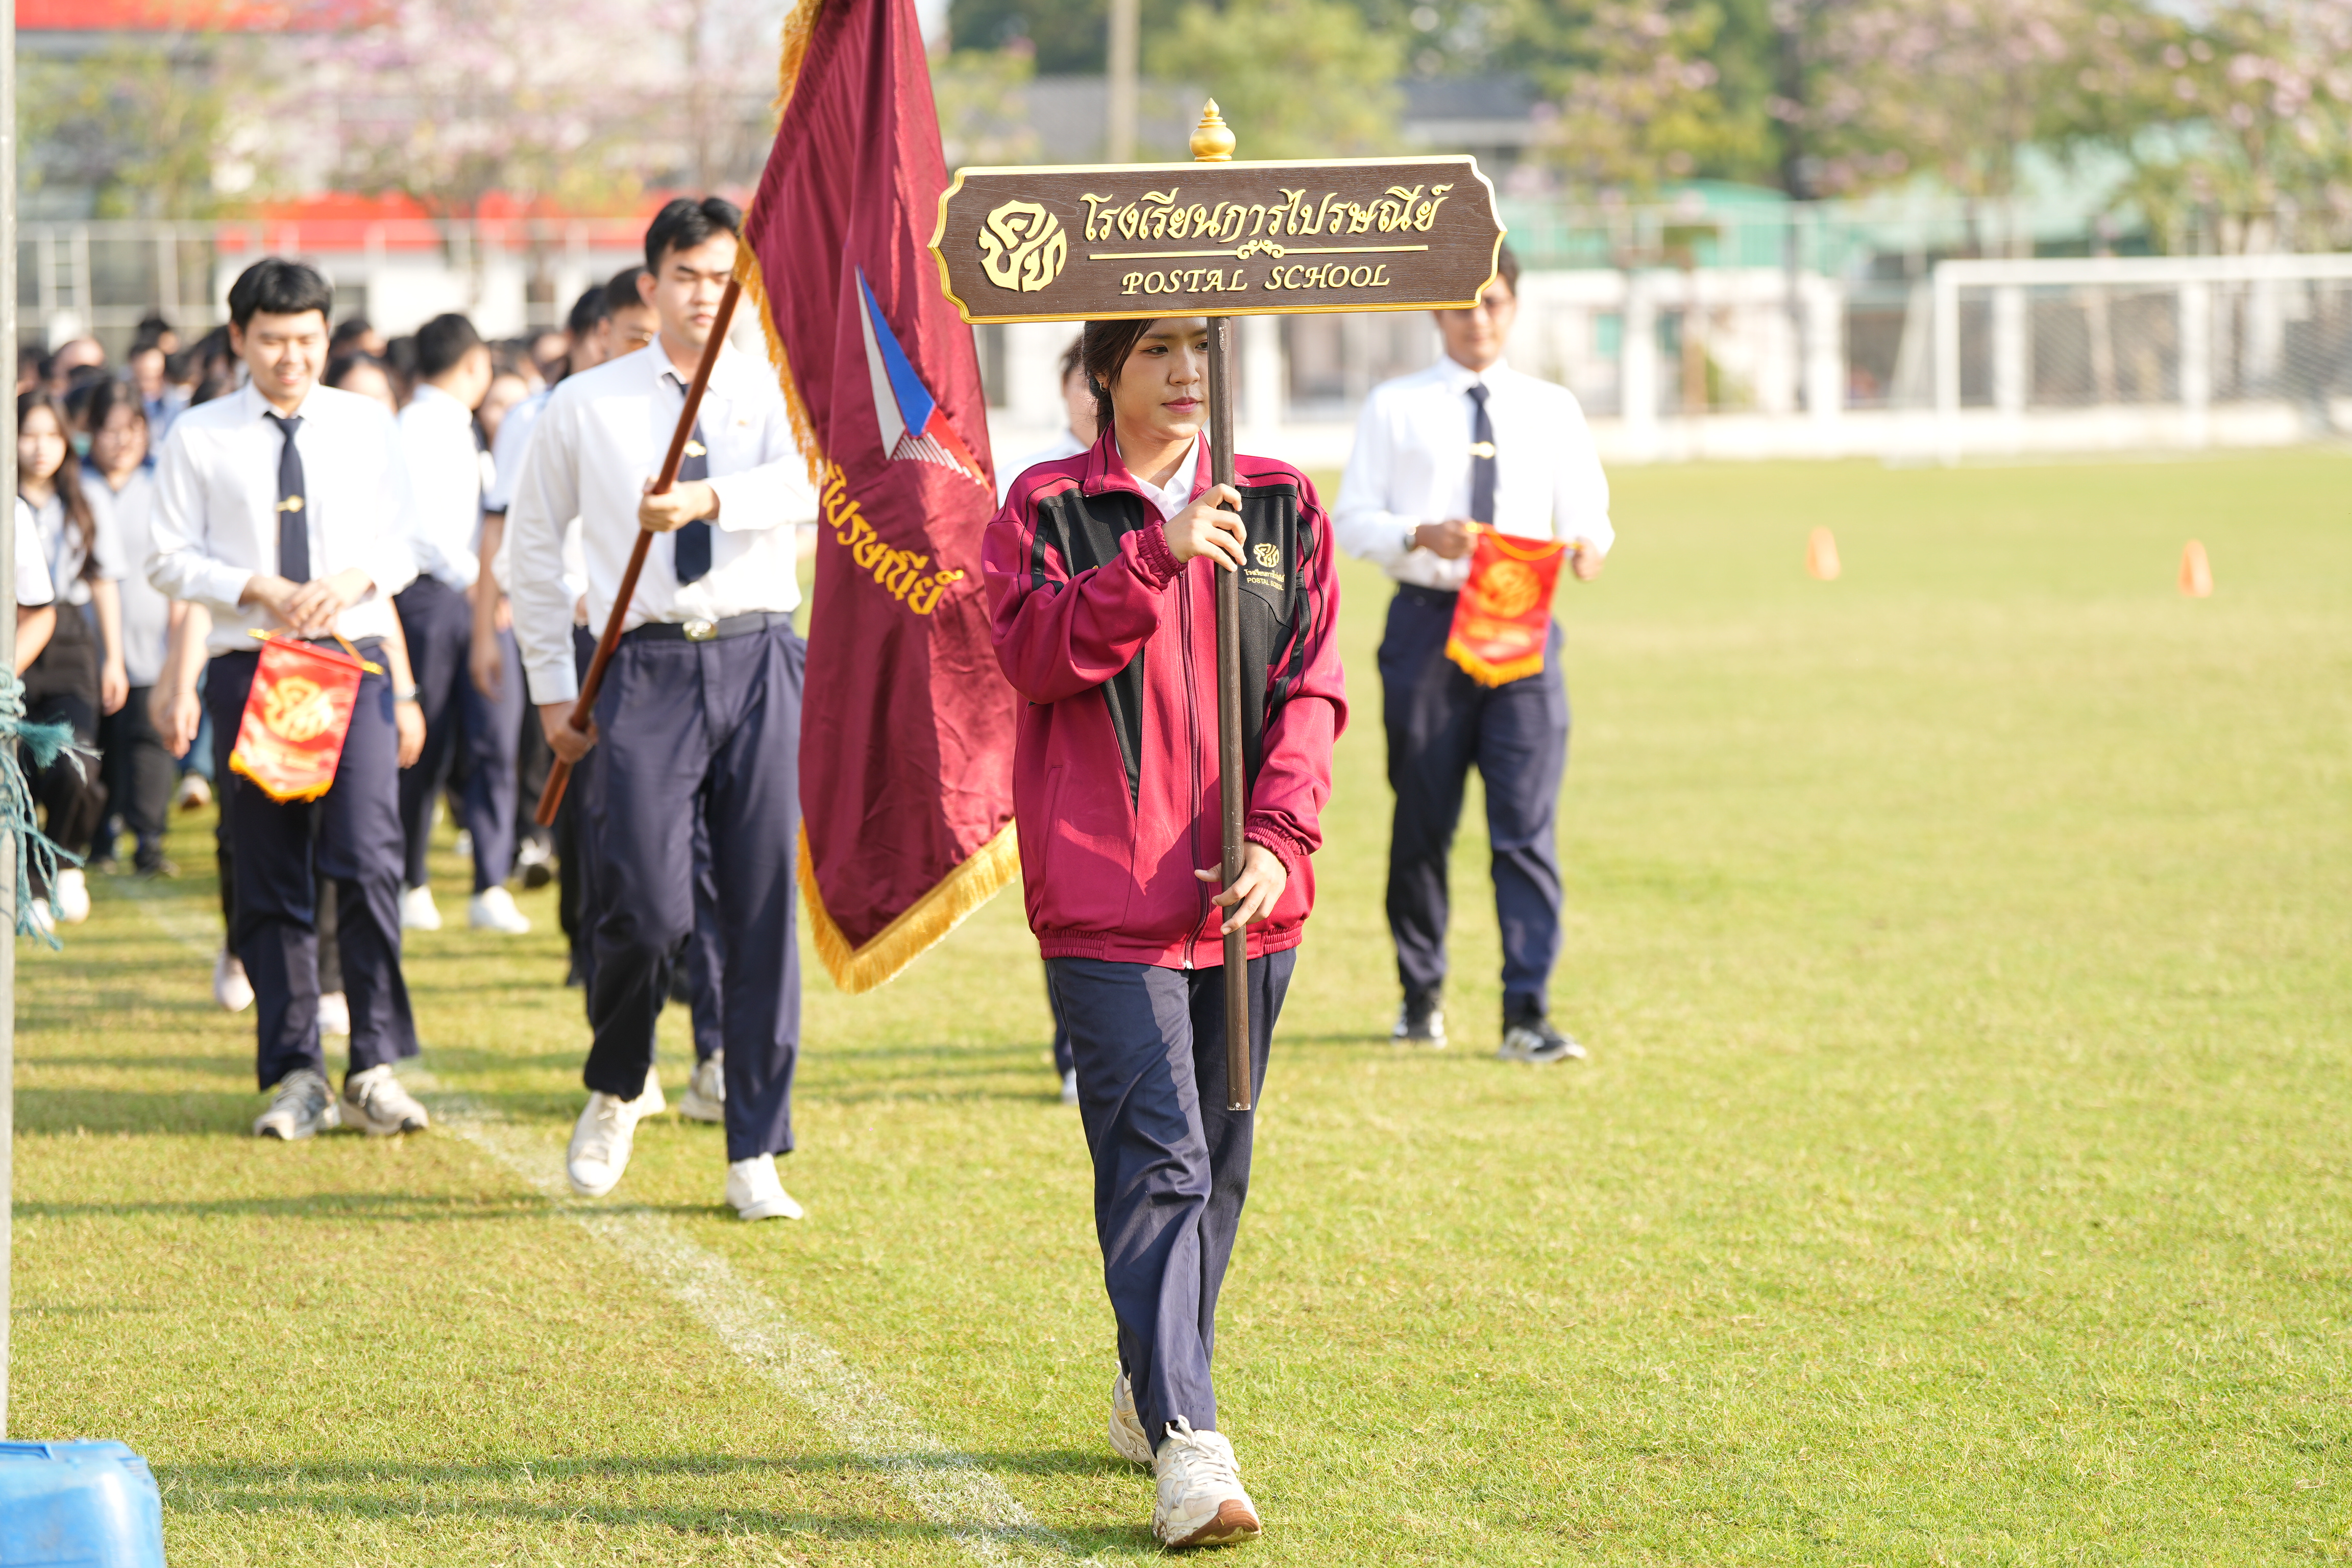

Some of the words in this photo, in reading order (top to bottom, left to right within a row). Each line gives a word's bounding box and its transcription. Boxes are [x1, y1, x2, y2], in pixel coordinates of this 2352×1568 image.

[1079, 183, 1454, 243] โรงเรียนการไปรษณีย์
[1121, 267, 1248, 295] POSTAL
[1264, 263, 1390, 290] SCHOOL
[1246, 577, 1270, 585] POSTAL
